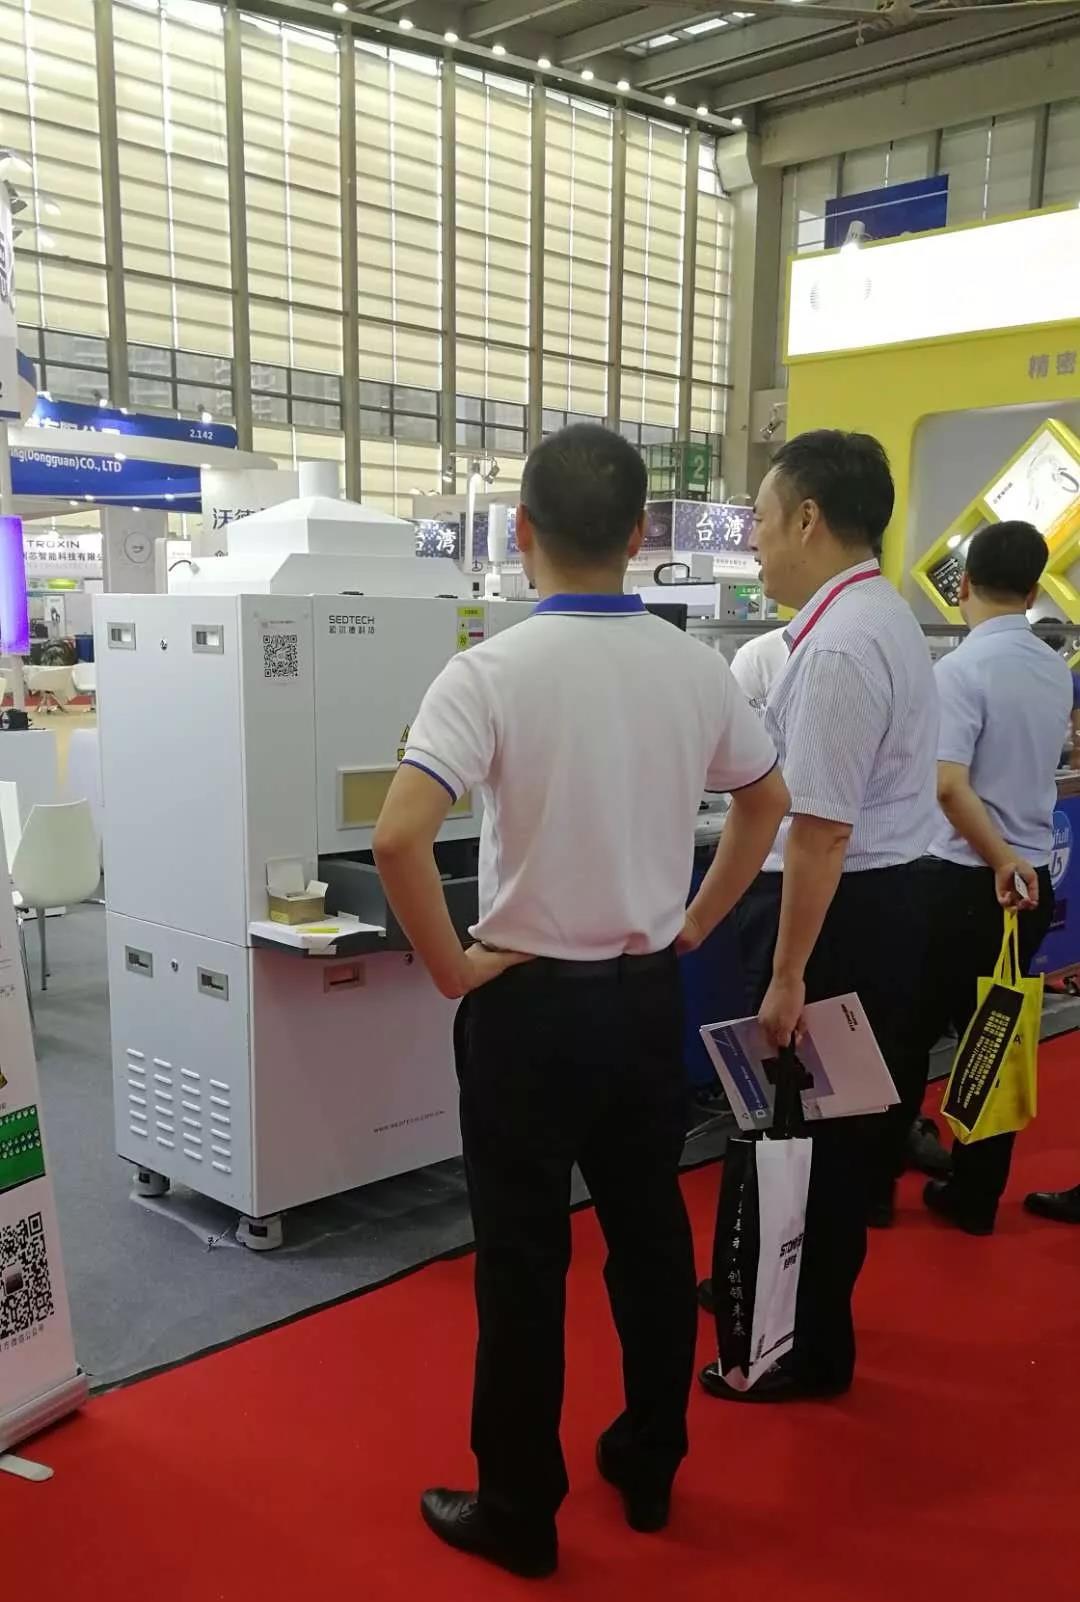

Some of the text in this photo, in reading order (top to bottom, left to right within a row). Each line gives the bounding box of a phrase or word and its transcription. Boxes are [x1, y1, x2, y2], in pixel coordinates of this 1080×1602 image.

[1028, 350, 1077, 380] 精密
[189, 428, 214, 441] 2.142
[101, 459, 122, 473] LTD
[693, 455, 706, 480] 2
[696, 512, 745, 545] 台湾
[328, 614, 375, 625] SEDTECH
